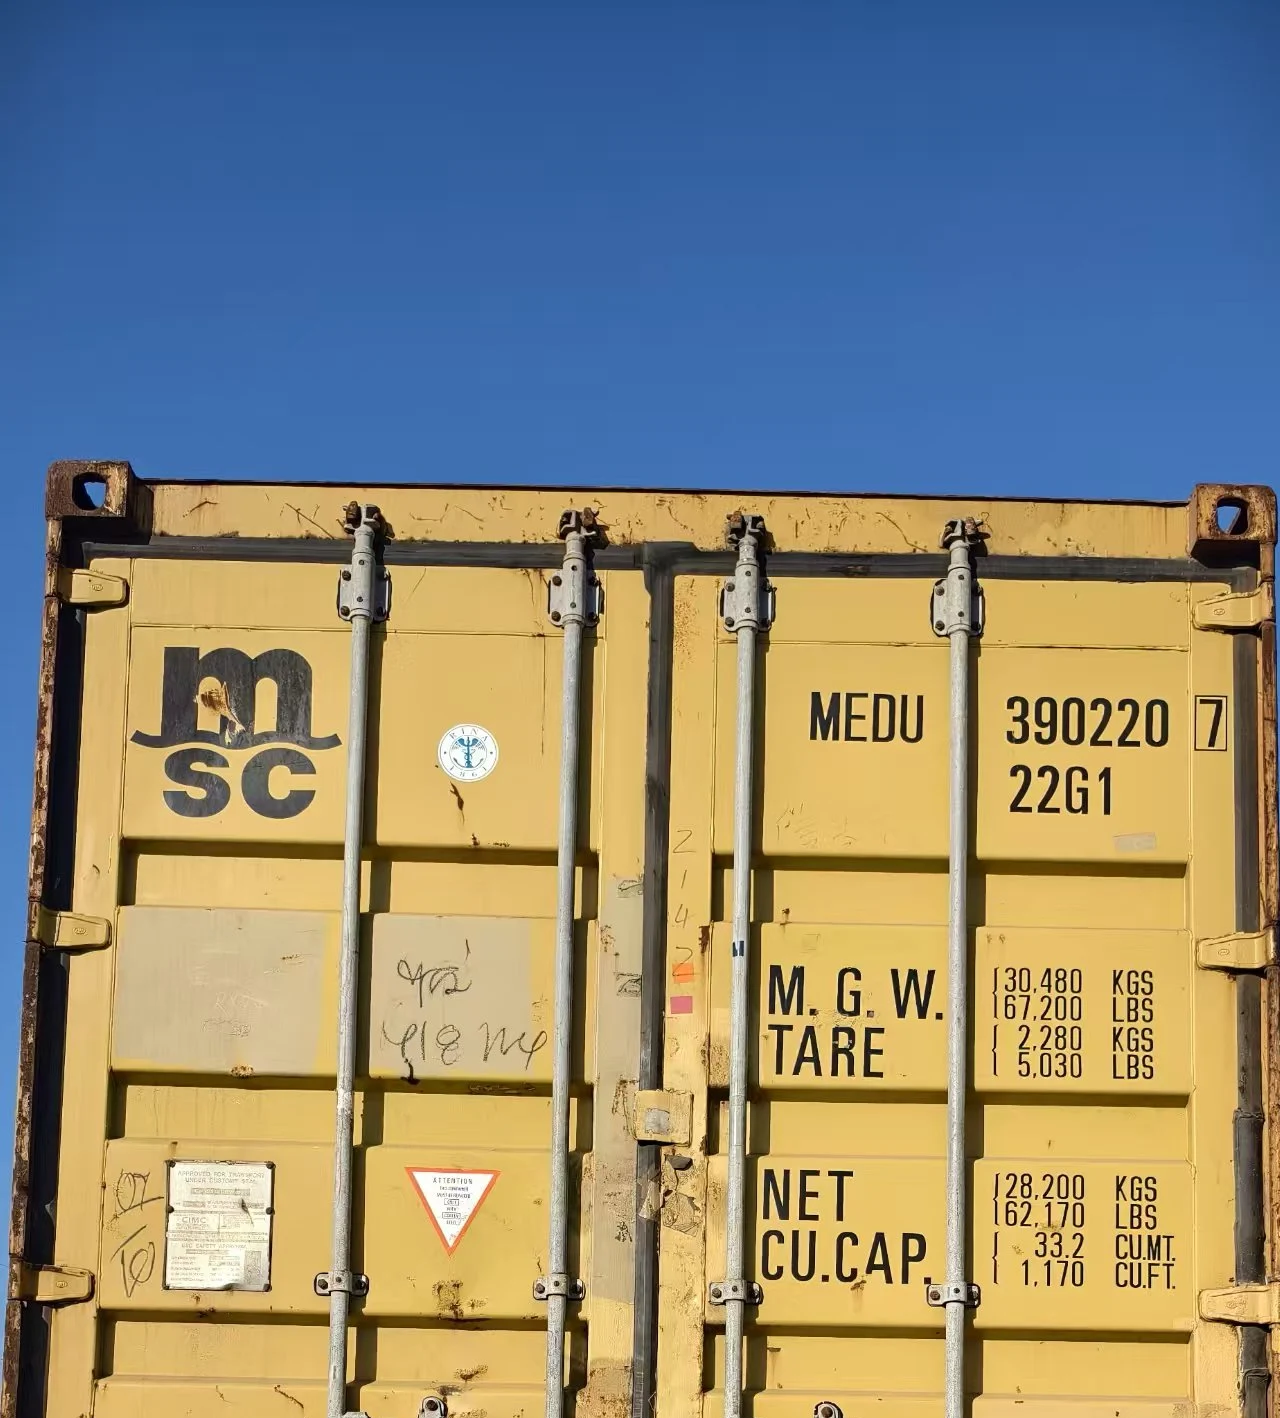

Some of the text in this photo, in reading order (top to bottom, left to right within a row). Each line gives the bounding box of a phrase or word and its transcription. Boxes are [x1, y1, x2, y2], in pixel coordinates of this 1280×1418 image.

[809, 691, 1223, 747] MEDU 390220 7
[1009, 765, 1111, 815] 22G1
[1113, 970, 1153, 995] KGS
[1113, 997, 1153, 1022] LBS
[768, 1025, 884, 1078] TARE
[1113, 1027, 1153, 1052] KGS
[1113, 1054, 1153, 1079] LBS
[763, 1169, 853, 1221] NET
[1116, 1176, 1157, 1202] KGS
[1116, 1203, 1157, 1230] LBS
[762, 1230, 933, 1284] CU.CAP.
[1035, 1232, 1084, 1258] 33.2
